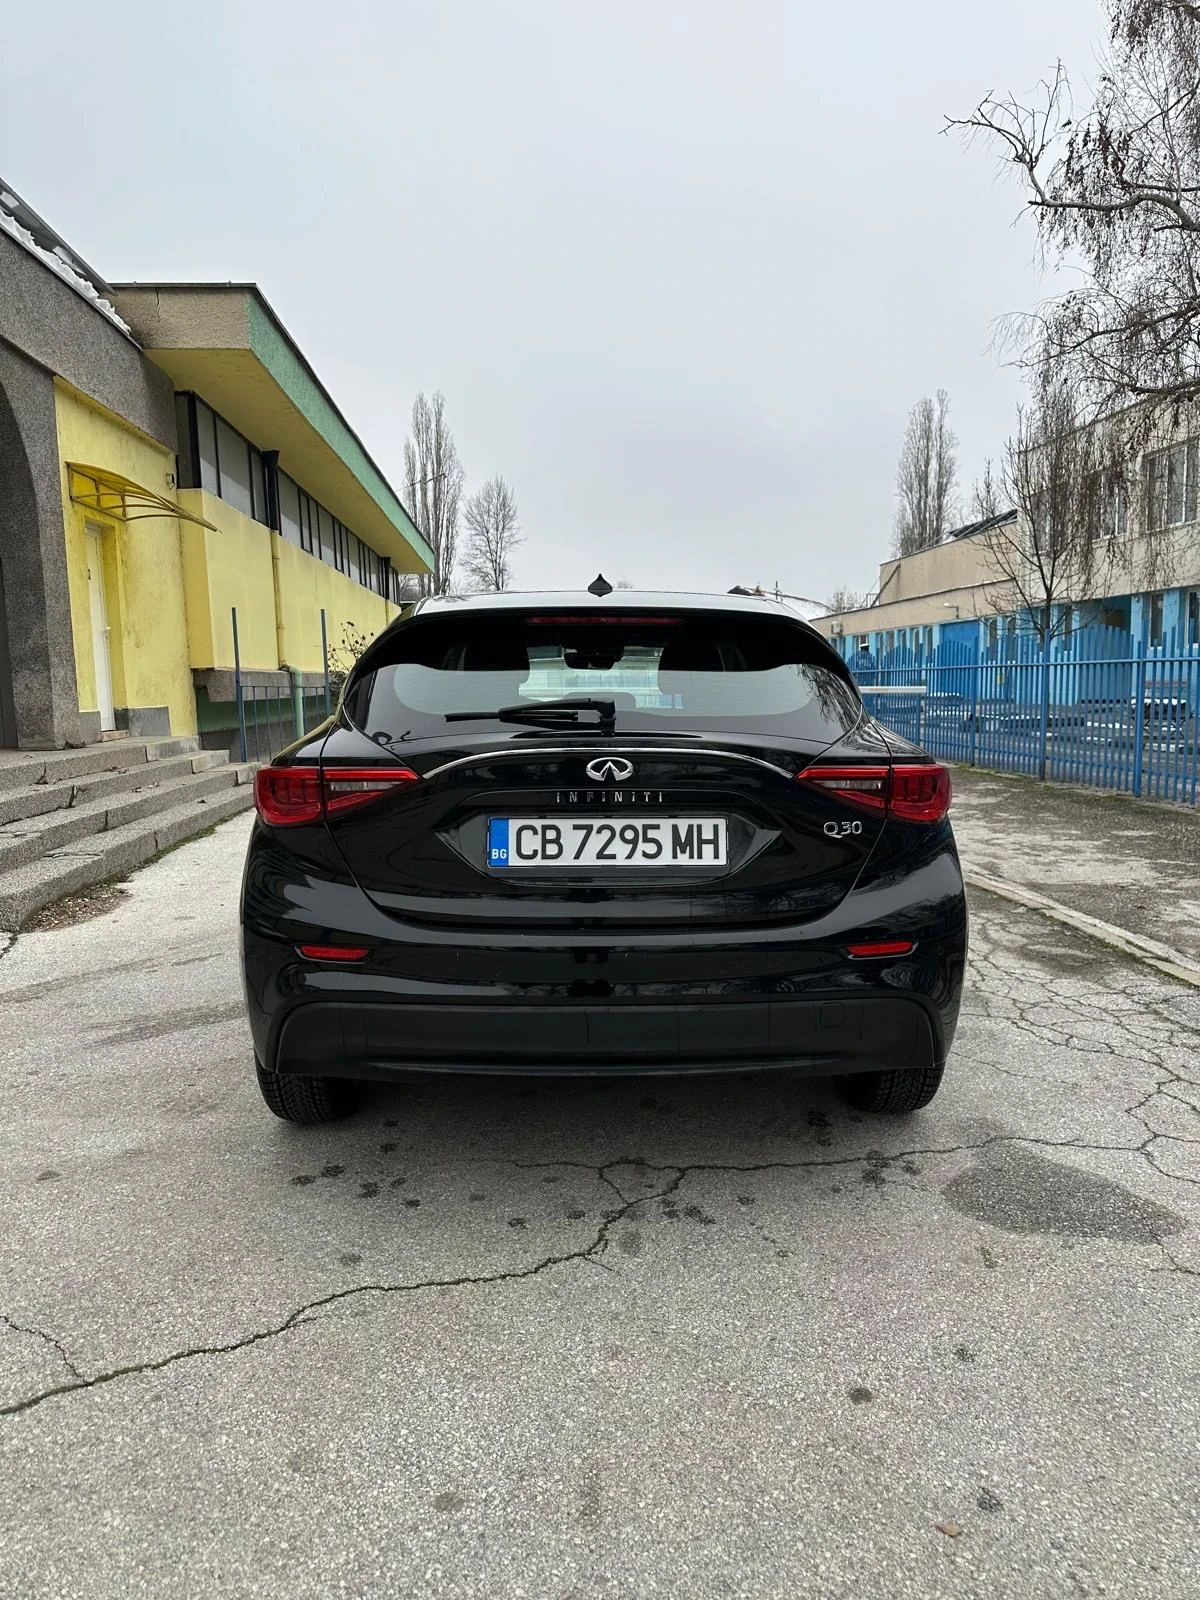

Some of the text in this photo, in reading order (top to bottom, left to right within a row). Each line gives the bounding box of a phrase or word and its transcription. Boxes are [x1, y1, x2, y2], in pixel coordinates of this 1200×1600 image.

[556, 791, 665, 804] INFINITI
[823, 820, 863, 839] Q30
[572, 823, 662, 861] 7295
[491, 848, 508, 861] BG
